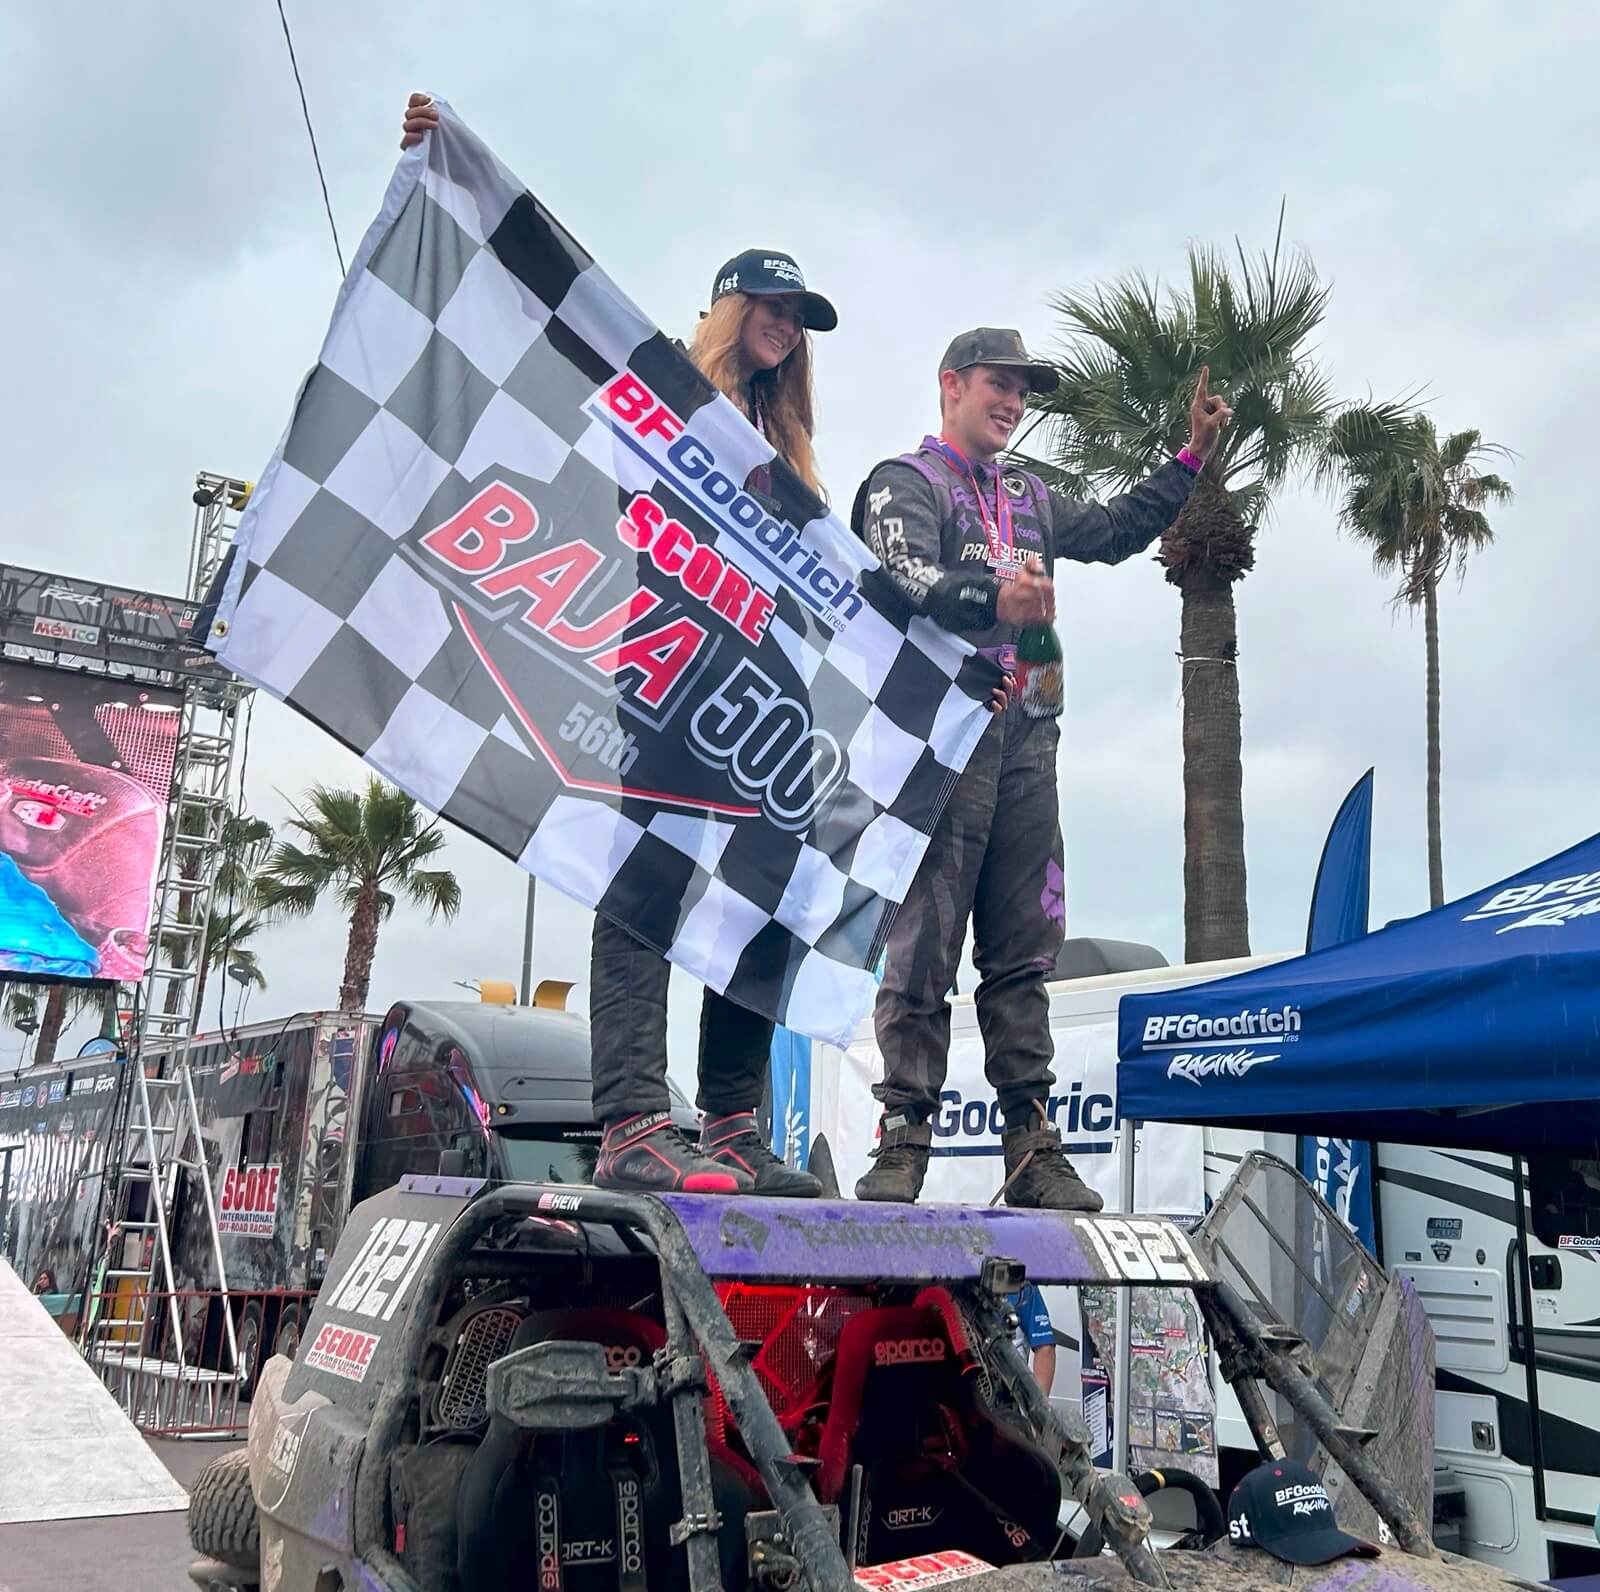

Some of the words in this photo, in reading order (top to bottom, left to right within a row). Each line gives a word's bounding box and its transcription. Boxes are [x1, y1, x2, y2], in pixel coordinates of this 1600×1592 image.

[719, 272, 739, 293] 1st
[599, 373, 867, 621] BFGoodrich
[616, 492, 777, 647] SCORE
[419, 479, 709, 710] BAJA
[823, 606, 847, 634] Tires
[558, 701, 640, 776] 56th
[690, 656, 845, 824] 500
[1142, 1005, 1300, 1042] BFGoodrich
[1283, 1033, 1299, 1043] Tires
[1167, 1048, 1281, 1088] RACING
[875, 1082, 1144, 1139] Gooric
[223, 1168, 280, 1212] SCORE
[552, 1194, 583, 1211] HEIN
[220, 1213, 273, 1224] INTERNATIONAL
[248, 1223, 273, 1235] RACING
[326, 1217, 442, 1321] 1821
[1072, 1217, 1209, 1282] 1821
[315, 1326, 377, 1366] SCORE
[875, 1338, 945, 1364] sparco
[537, 1493, 557, 1589] sparco
[622, 1479, 642, 1572] sparco
[1229, 1513, 1251, 1538] st
